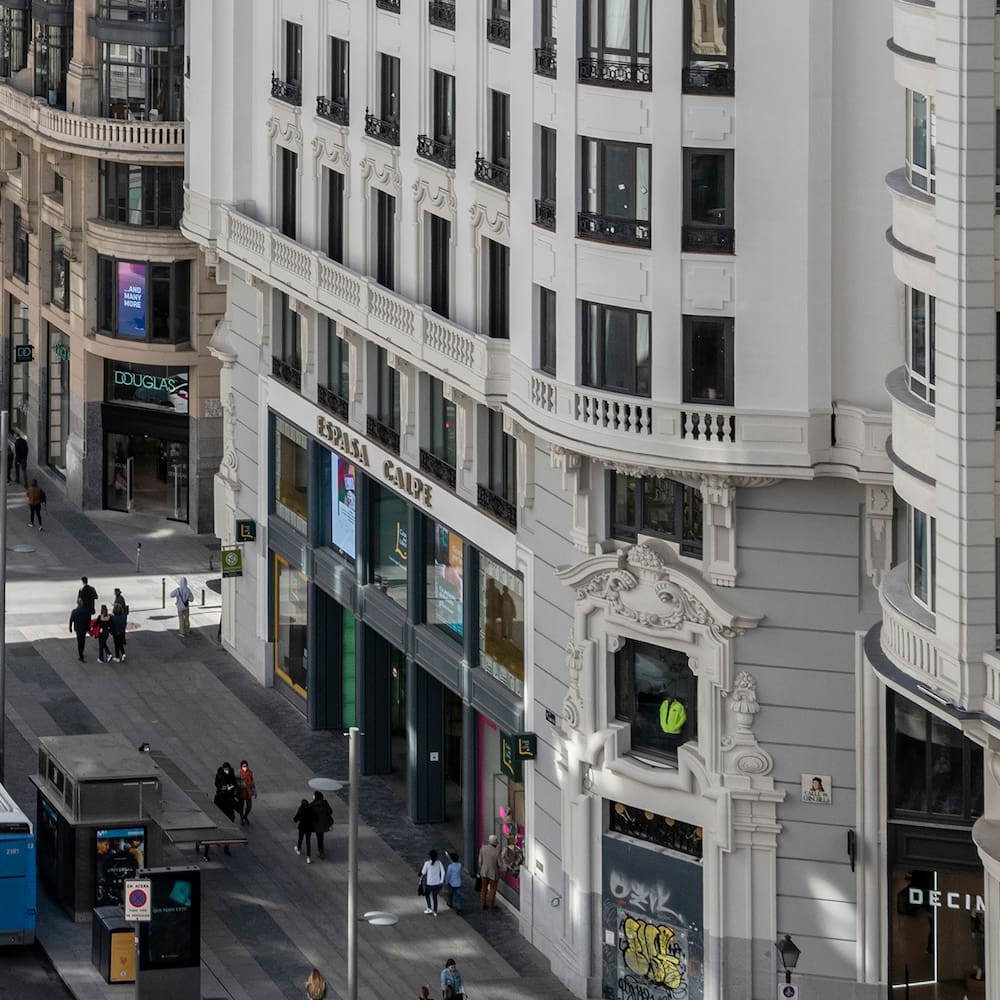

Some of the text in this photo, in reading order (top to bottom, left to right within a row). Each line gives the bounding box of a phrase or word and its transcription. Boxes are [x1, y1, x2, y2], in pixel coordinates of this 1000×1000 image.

[123, 293, 142, 301] MANY
[123, 300, 142, 309] MORE
[114, 370, 176, 393] DOUGLAS
[316, 415, 370, 468] ESPASA
[384, 460, 433, 508] CALPE
